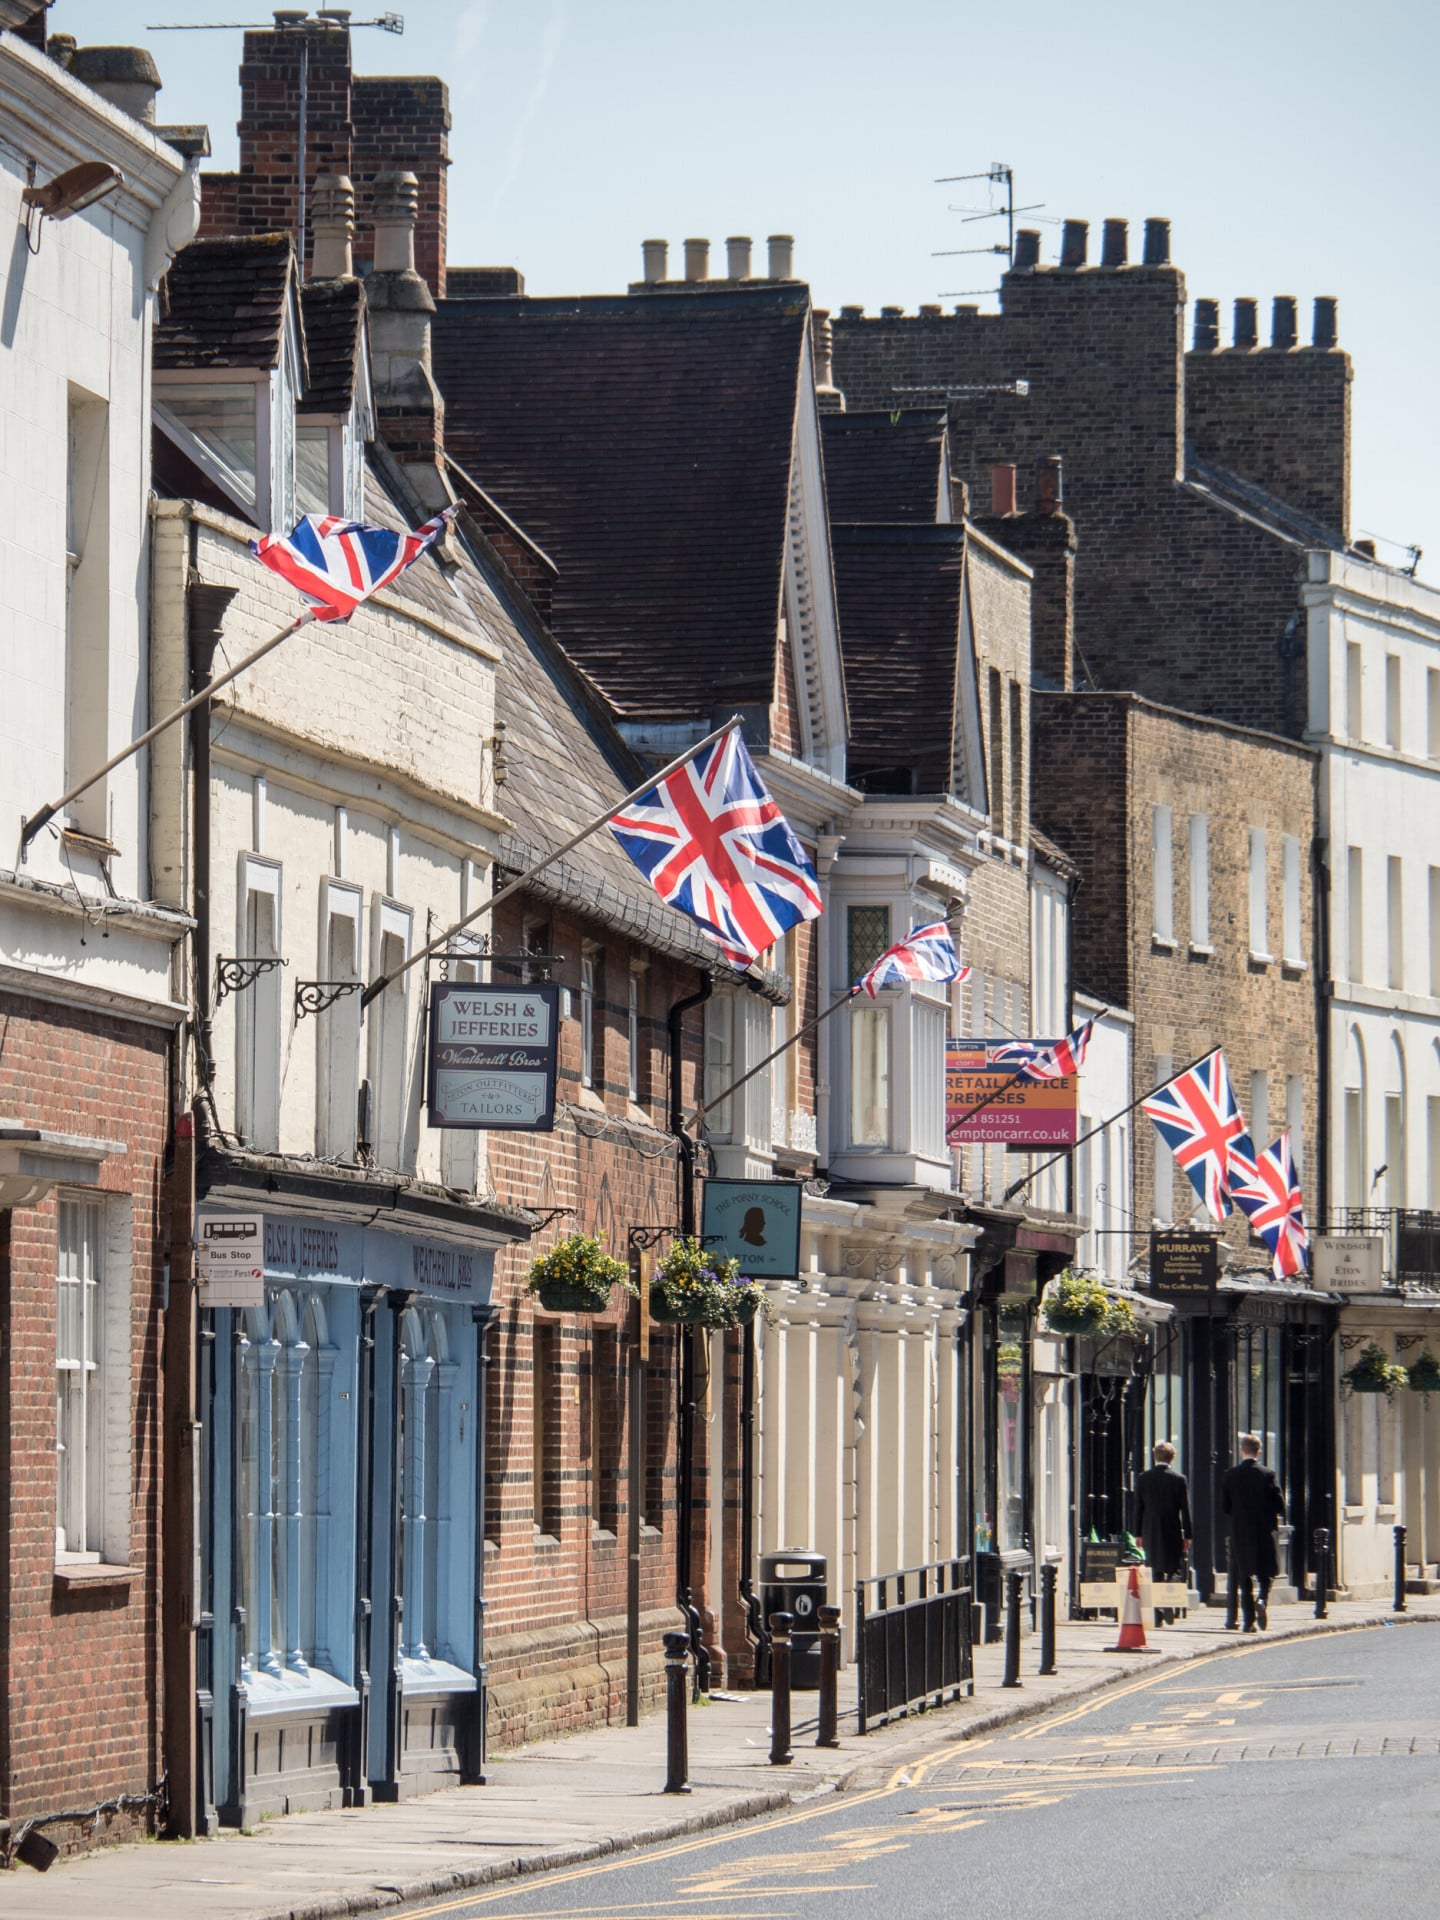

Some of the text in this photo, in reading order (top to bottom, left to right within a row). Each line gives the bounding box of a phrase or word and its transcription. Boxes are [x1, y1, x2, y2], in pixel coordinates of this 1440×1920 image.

[453, 1001, 535, 1017] WELSH &
[450, 1021, 538, 1038] JEFFERIES
[442, 1046, 541, 1066] Weatherill Bros
[451, 1079, 532, 1102] ETON OUTFITTERS
[461, 1102, 522, 1114] TAILORS
[945, 1114, 1021, 1124] 0173 851251
[264, 1223, 288, 1263] ELSH
[298, 1227, 338, 1272] JEFFERIES
[1156, 1243, 1211, 1253] MURRAYS
[210, 1251, 252, 1260] Bus Stop
[234, 1269, 251, 1278] First
